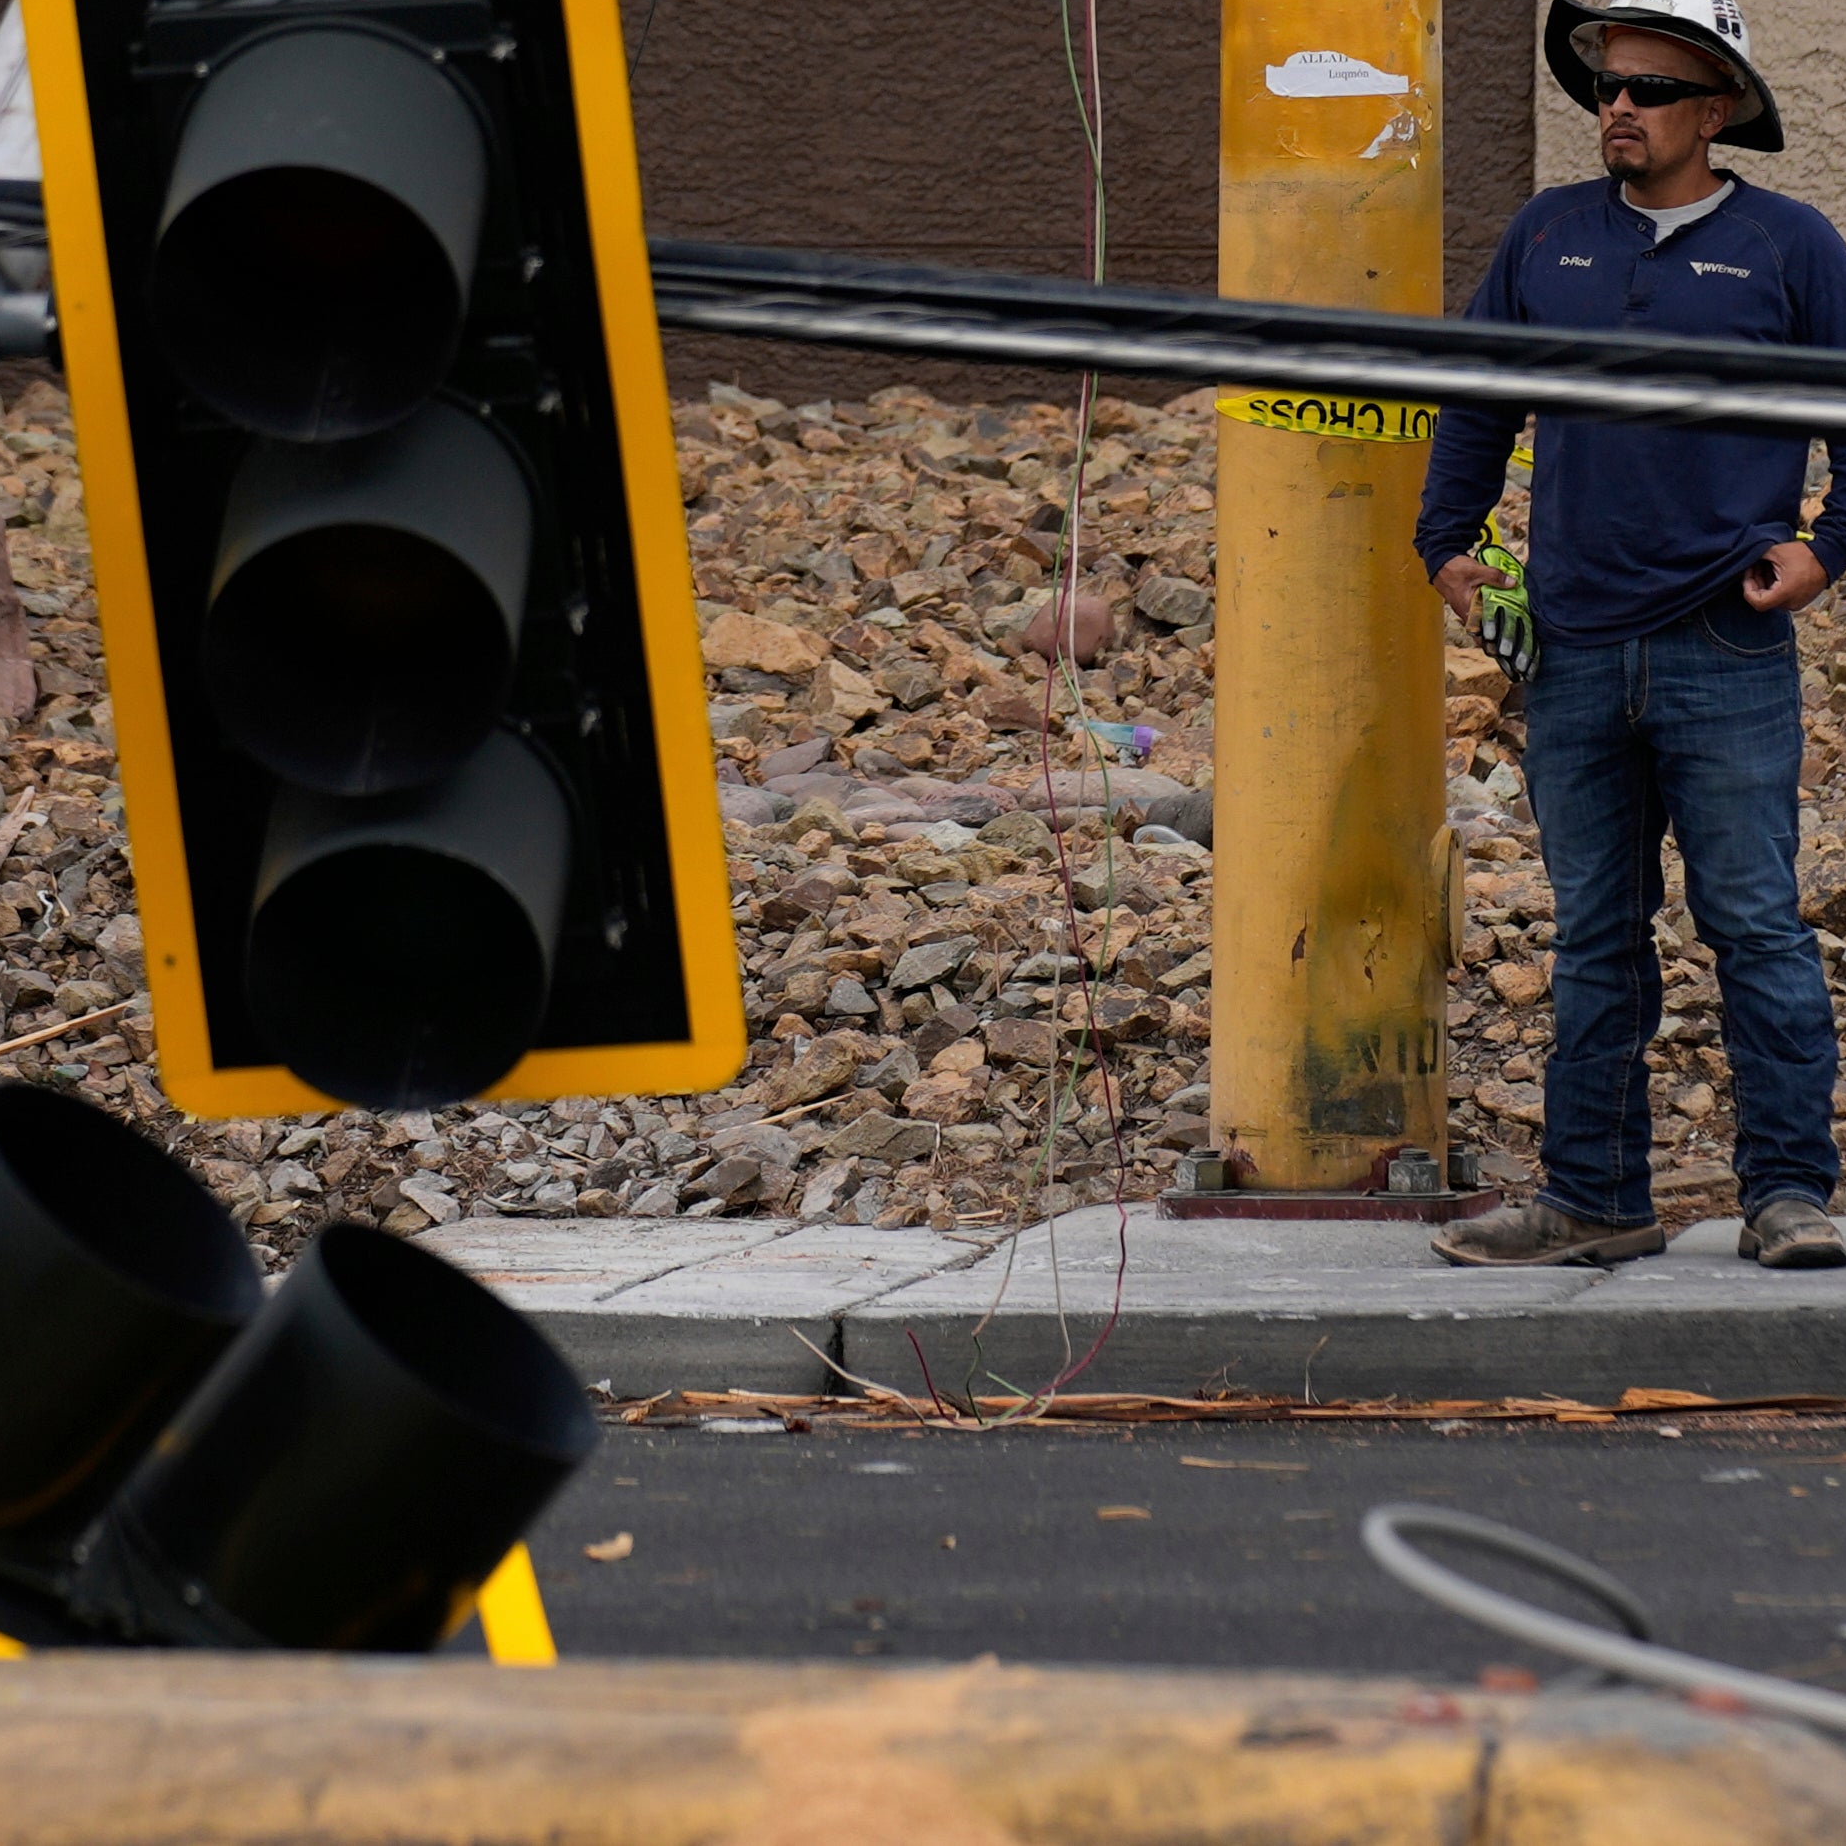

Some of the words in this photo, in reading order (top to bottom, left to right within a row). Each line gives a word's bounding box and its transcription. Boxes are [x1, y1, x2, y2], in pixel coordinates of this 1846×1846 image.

[1559, 256, 1593, 267] D-Rod
[1249, 399, 1384, 439] CROSS
[1400, 406, 1439, 439] OT
